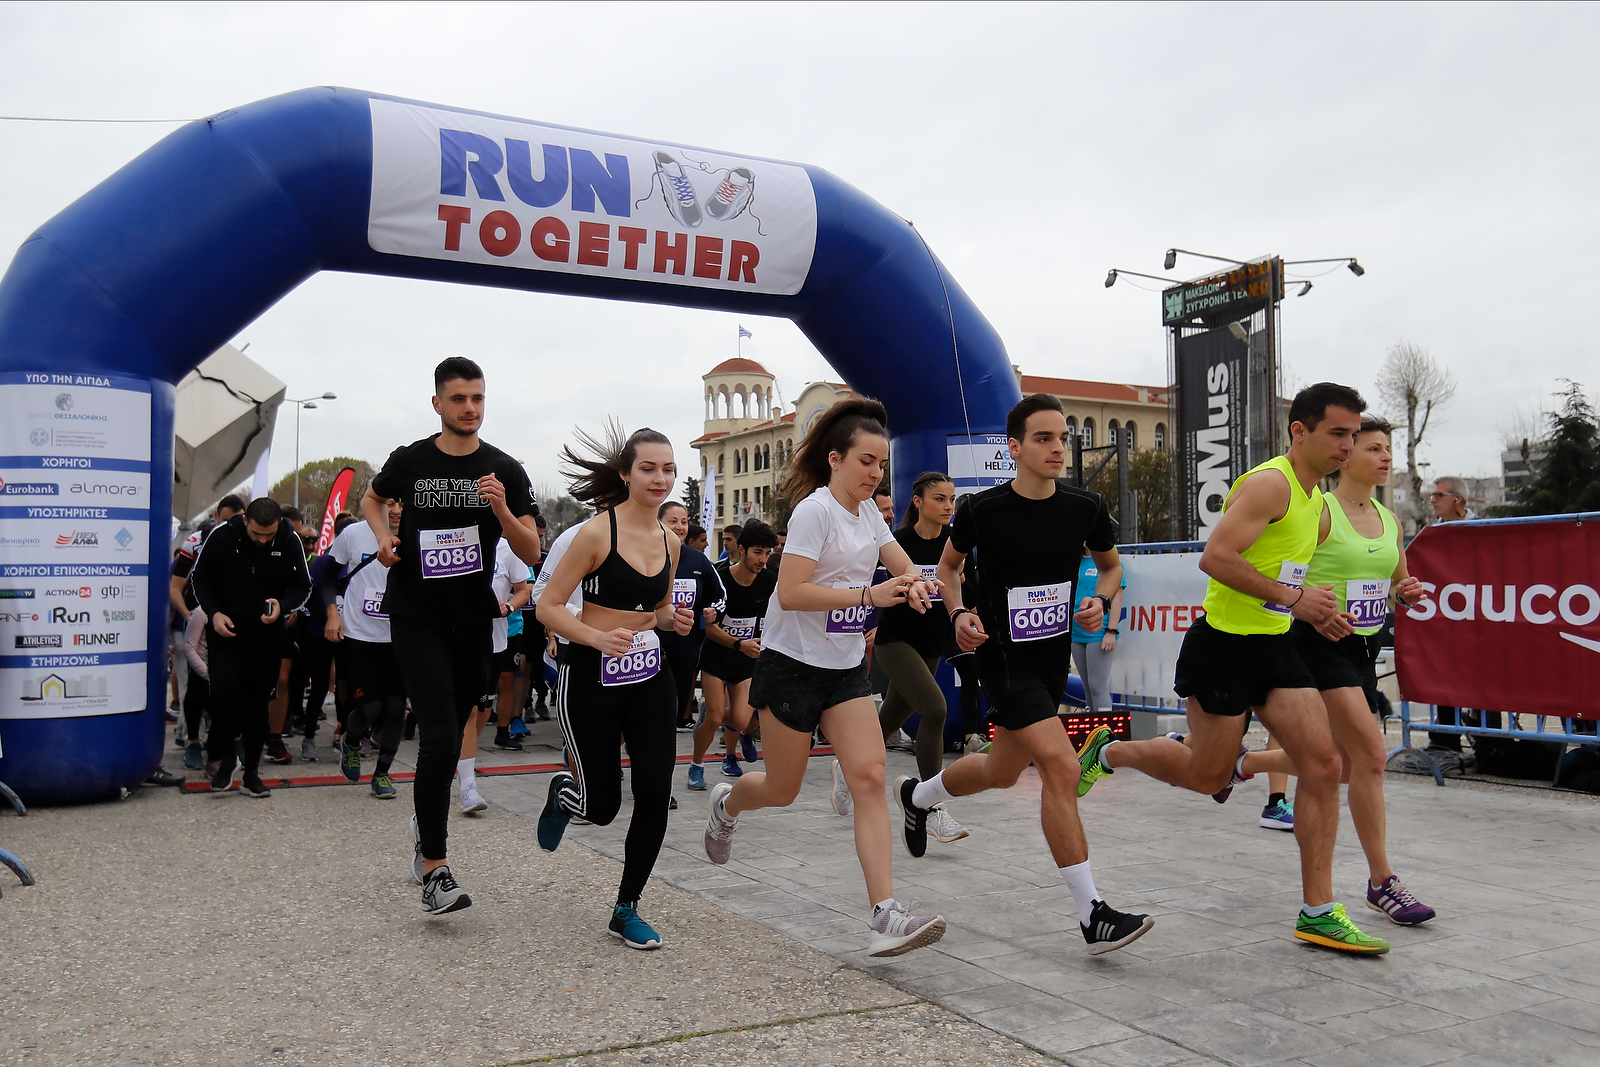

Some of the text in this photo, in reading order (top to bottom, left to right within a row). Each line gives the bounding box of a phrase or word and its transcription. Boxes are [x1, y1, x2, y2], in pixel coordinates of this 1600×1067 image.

[439, 128, 631, 217] RUN
[437, 204, 760, 284] TOGETHER
[1186, 292, 1230, 314] ΣΥΓΧΡΟΝΗΣ
[26, 374, 110, 387] ΥΠΟ ΤΗΝ ΑΙΓΙΔΑ
[54, 413, 108, 421] ΘΕΣΣΑΛΟΝΙΚΗΣ
[42, 458, 92, 468] ΧΟΡΗΓΟΙ
[6, 485, 54, 494] Eurobank
[415, 479, 448, 491] ONE
[414, 491, 491, 508] UNITED
[28, 508, 108, 518] ΥΠΟΣΤΗΡΙΚΤΕΣ
[426, 546, 478, 567] 6086
[4, 566, 130, 576] ΧΟΡΗΓΟΙ ΕΠΙΚΟΙΝΩΝΙΑΣ
[80, 587, 90, 596] 24
[101, 586, 120, 599] gtp
[1350, 599, 1386, 619] 6102
[1014, 605, 1066, 628] 6068
[722, 626, 752, 636] 6052
[23, 636, 60, 644] ATHLETICS
[31, 656, 99, 667] ΣΤΗΡΙΖΟΥΜΕ
[606, 650, 657, 675] 6086
